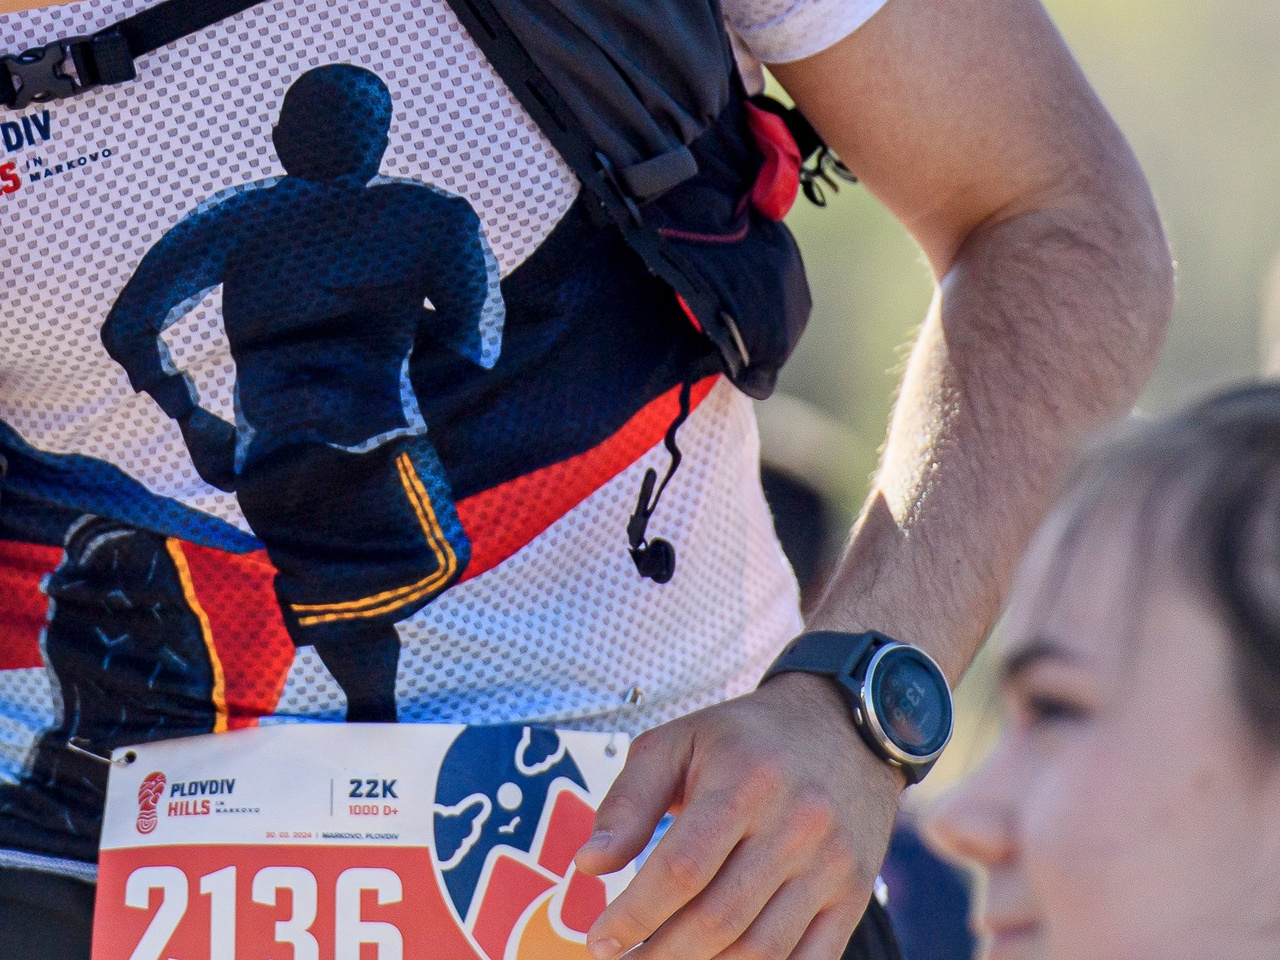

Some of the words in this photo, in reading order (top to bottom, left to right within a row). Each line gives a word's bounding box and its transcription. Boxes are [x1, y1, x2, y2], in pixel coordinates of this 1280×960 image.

[25, 156, 43, 170] IN
[29, 148, 112, 183] MARKOVO
[169, 778, 236, 798] PLOVDIV
[348, 778, 399, 799] 22K
[167, 799, 211, 817] HILLS
[348, 804, 380, 816] 1000
[382, 805, 399, 816] D+
[124, 865, 405, 960] 2136
